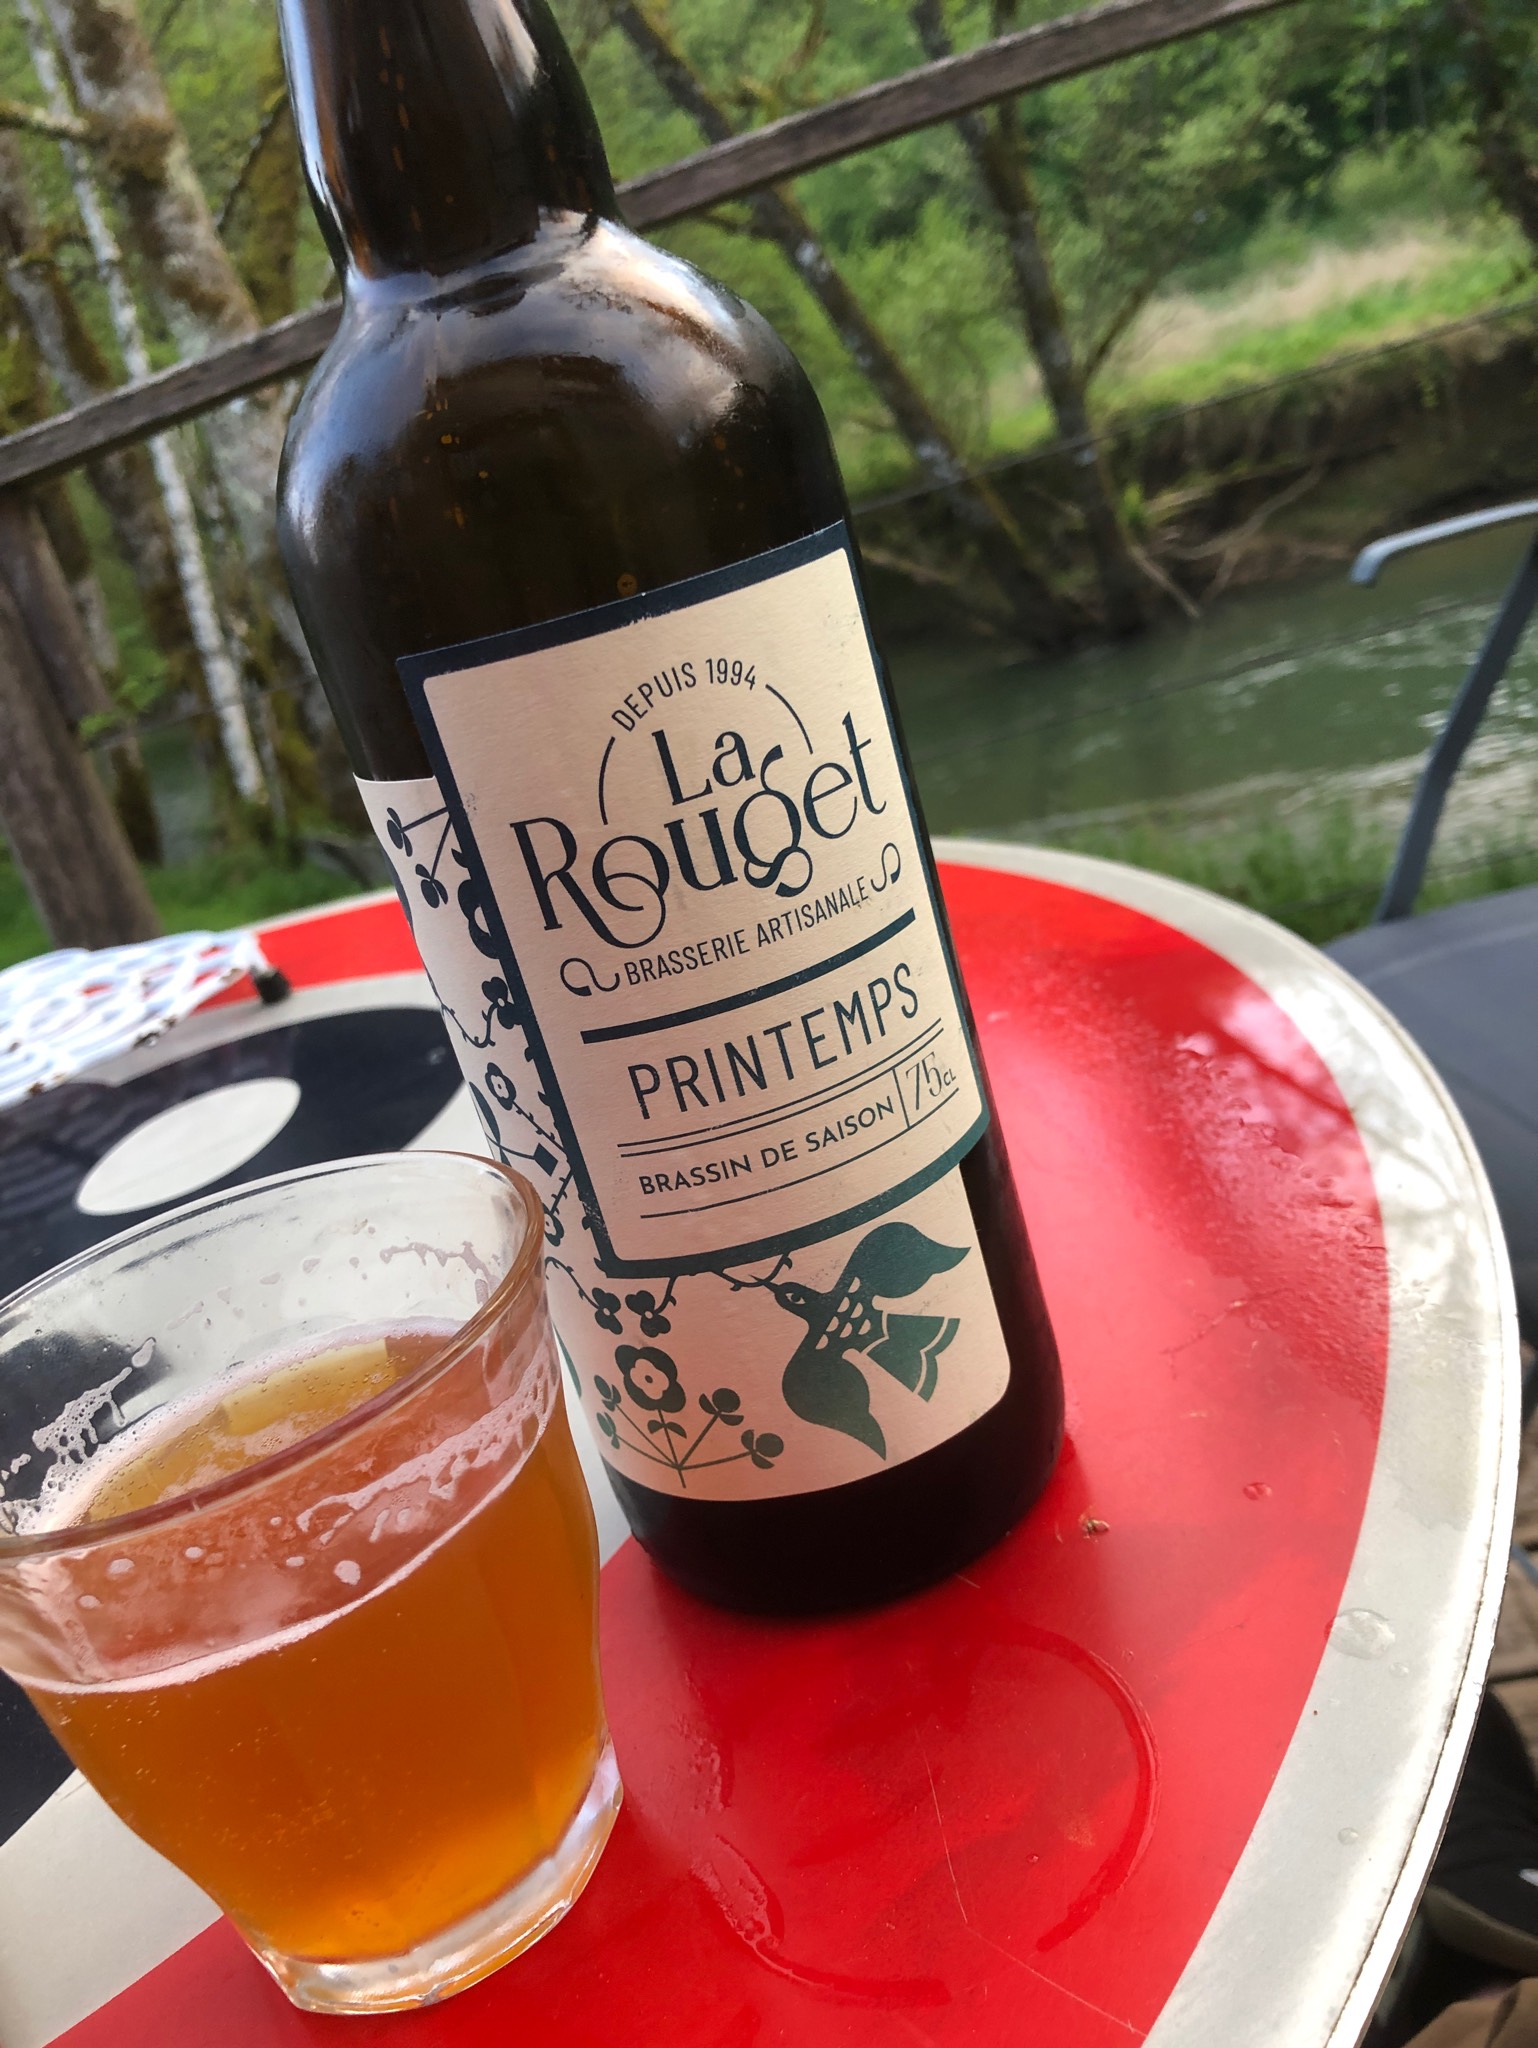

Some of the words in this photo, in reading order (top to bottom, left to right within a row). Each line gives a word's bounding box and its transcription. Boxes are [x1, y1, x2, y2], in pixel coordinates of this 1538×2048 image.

[611, 661, 698, 732] DEPUIS
[704, 657, 757, 691] 1994
[651, 729, 756, 806] La
[509, 711, 887, 949] Rouget
[624, 929, 751, 986] BRASSERIE
[756, 875, 869, 948] ARTISANALE
[627, 962, 920, 1120] PRINTEMPS
[638, 1154, 752, 1196] BRASSIN
[760, 1140, 799, 1170] DE
[805, 1095, 895, 1153] SAISON
